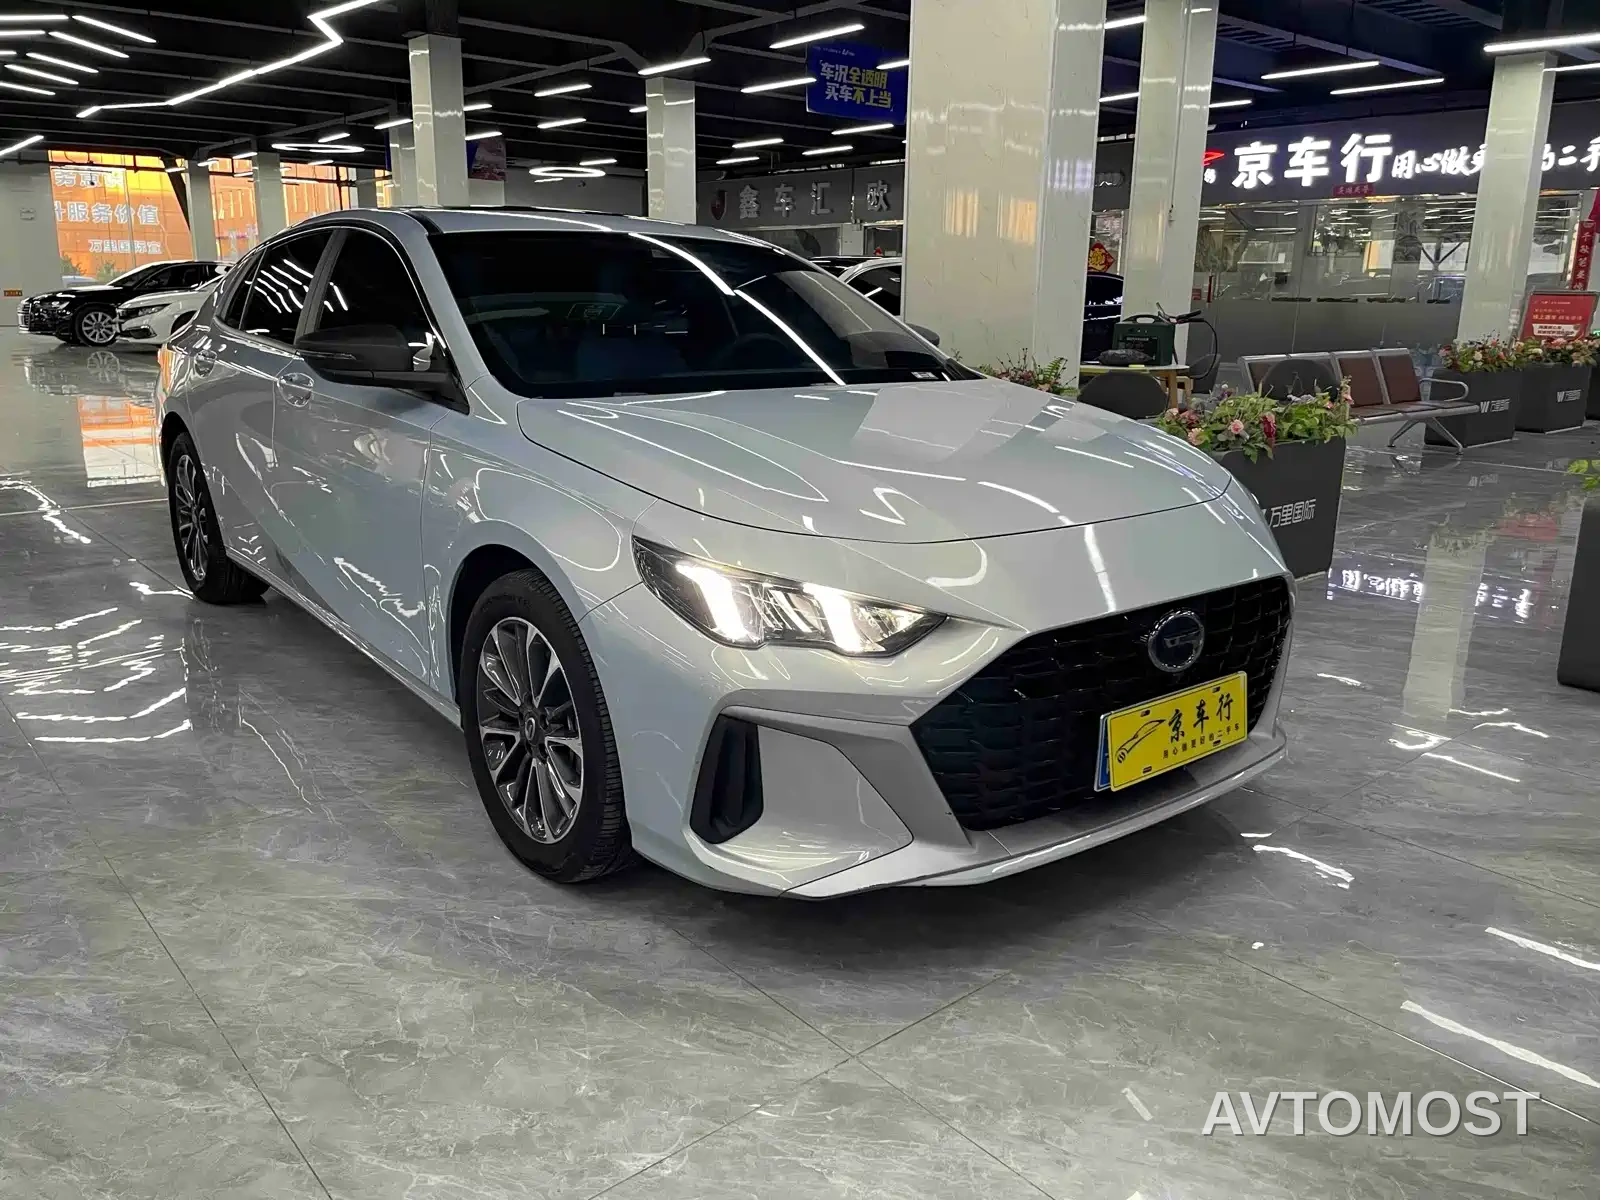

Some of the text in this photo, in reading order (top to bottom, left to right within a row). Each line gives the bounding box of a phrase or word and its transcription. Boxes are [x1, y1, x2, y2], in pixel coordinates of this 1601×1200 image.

[1231, 132, 1393, 190] 京车行
[1269, 498, 1317, 528] 万里国际
[1168, 692, 1234, 744] 京车行
